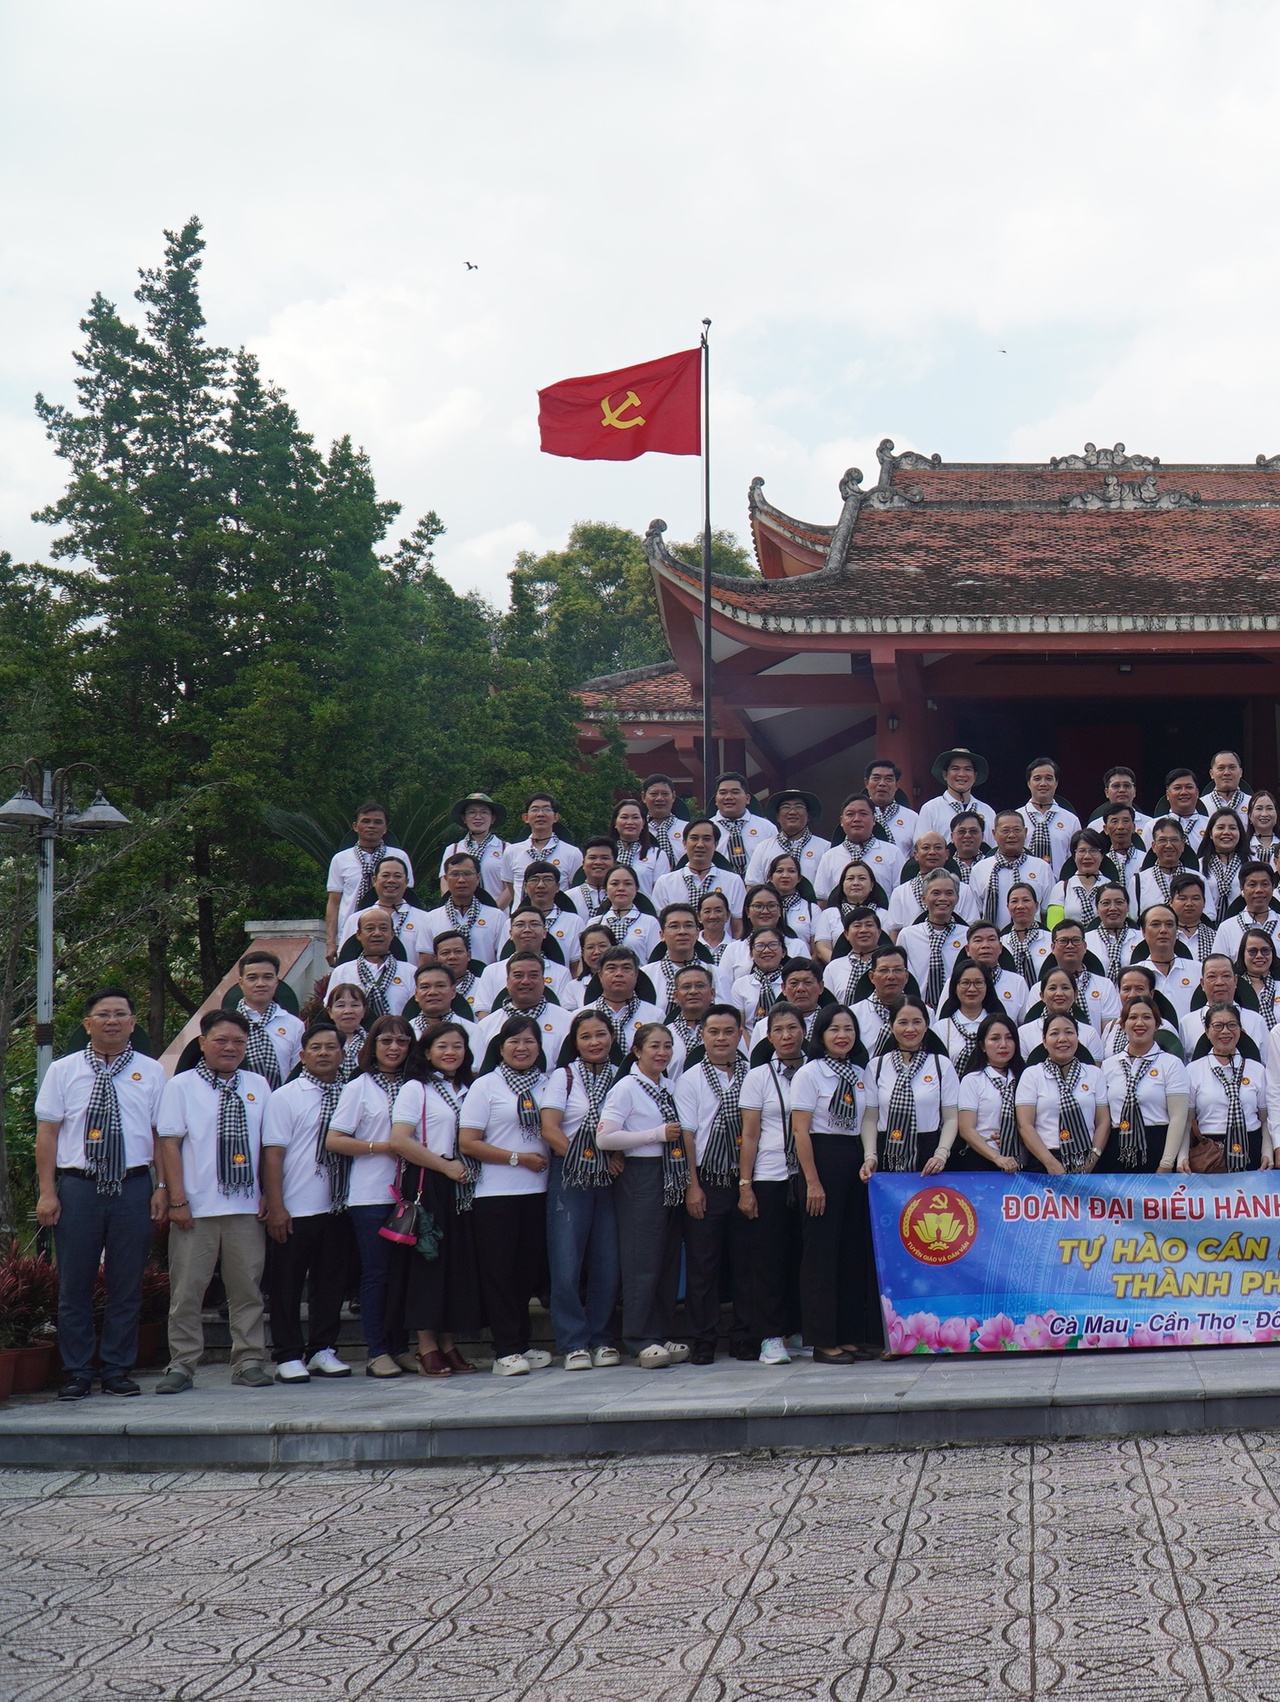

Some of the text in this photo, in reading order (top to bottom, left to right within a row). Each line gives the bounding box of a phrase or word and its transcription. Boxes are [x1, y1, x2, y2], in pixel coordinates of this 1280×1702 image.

[1003, 1189, 1080, 1220] ĐOÀN
[1088, 1197, 1133, 1225] ĐẠI
[1143, 1184, 1204, 1220] BIỂU
[1058, 1234, 1105, 1270] TỰ
[1112, 1231, 1187, 1263] HÀO
[1197, 1231, 1270, 1262] CÁN
[1112, 1267, 1231, 1299] THÀNH
[1050, 1315, 1077, 1335] Cà
[1084, 1315, 1128, 1334] Mau
[1149, 1311, 1190, 1332] Cần
[1197, 1312, 1237, 1331] Thơ
